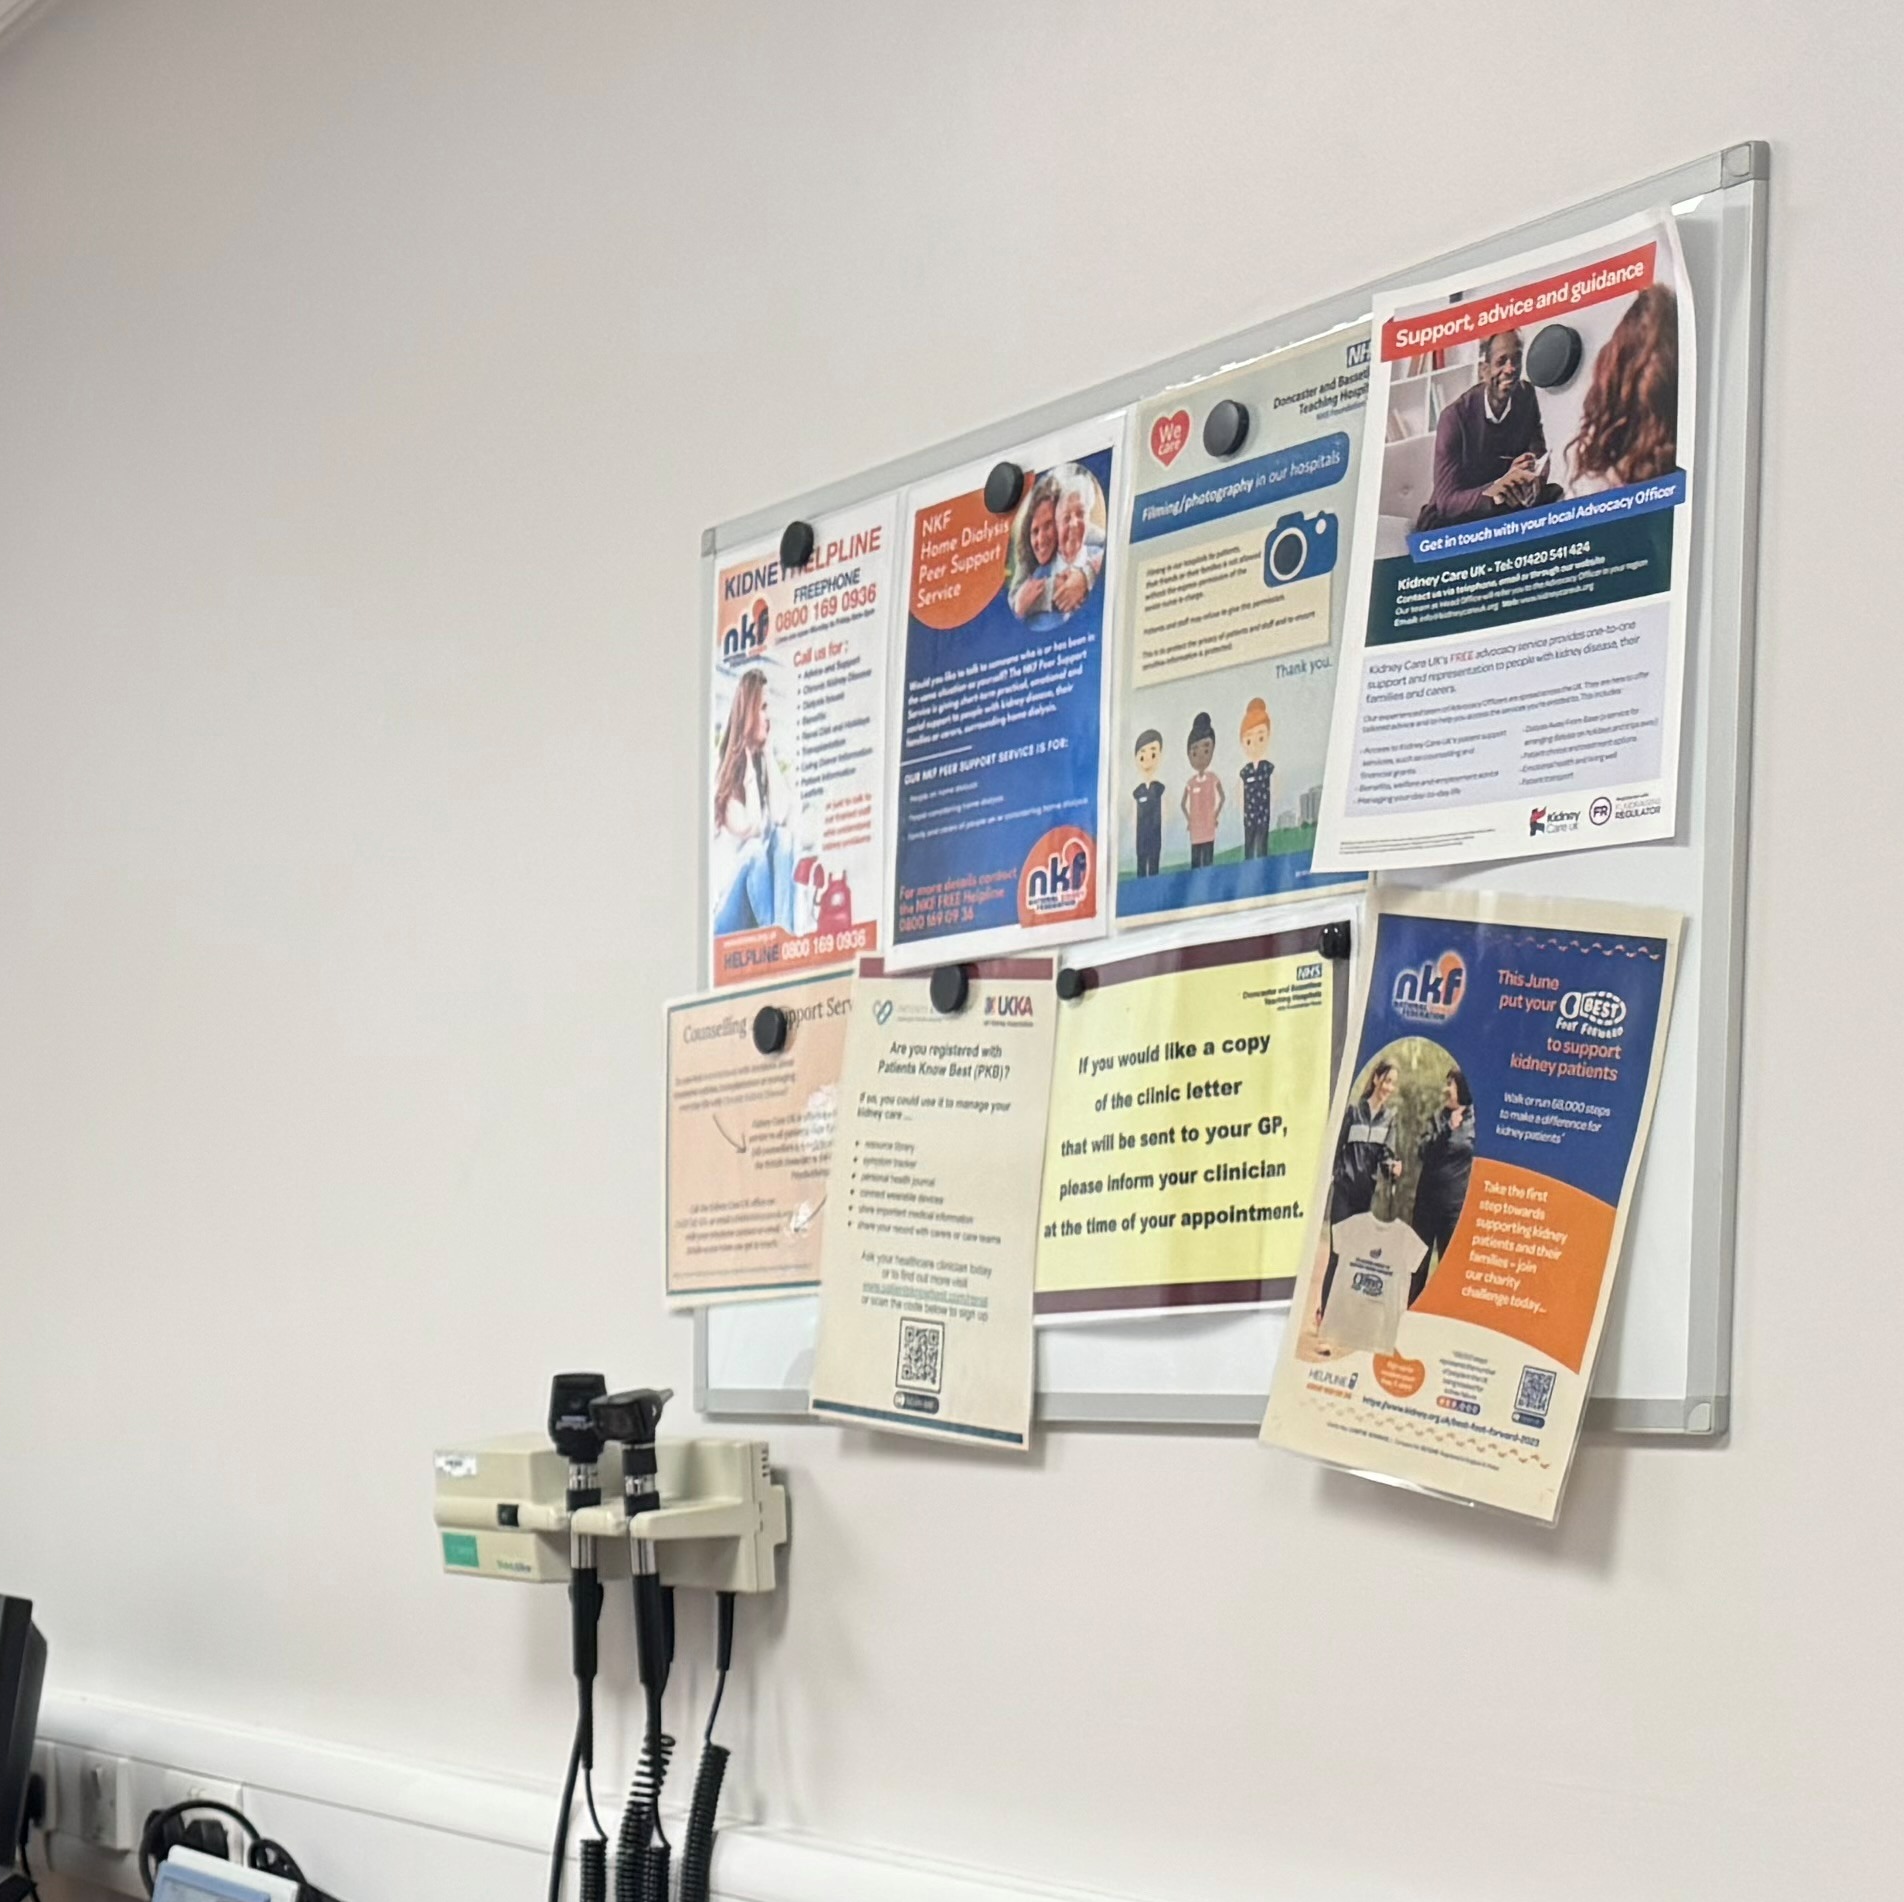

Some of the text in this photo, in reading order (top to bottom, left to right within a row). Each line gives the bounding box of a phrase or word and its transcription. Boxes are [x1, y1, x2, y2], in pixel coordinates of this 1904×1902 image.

[1396, 262, 1643, 347] Support, advice and guidance
[1273, 376, 1337, 409] Doncaster and
[1299, 395, 1338, 415] Teaching
[1158, 436, 1181, 455] care
[1159, 424, 1181, 443] We
[1142, 450, 1340, 520] Filming/photography in our hospitals
[922, 510, 951, 536] NKF
[1419, 485, 1675, 552] Get in touch with your local Advocacy Officer
[921, 514, 1009, 559] Home Dialysis
[790, 526, 882, 578] ELPLINE
[919, 544, 1000, 583] Peer Support
[1398, 541, 1590, 590] Kidney Care UK Tel: 01420 541 424
[794, 568, 859, 602] FREEPHONE
[917, 583, 961, 607] Service
[775, 605, 808, 632] 0800
[814, 595, 837, 619] 169
[841, 583, 876, 611] 0936
[724, 606, 768, 654] nkf
[793, 641, 842, 667] Call us for
[1276, 660, 1307, 679] Thank
[904, 772, 920, 785] OUR
[939, 762, 957, 776] PEER
[959, 753, 996, 772] SUPPORT
[998, 744, 1033, 762] SERVICE
[1036, 742, 1045, 753] IS
[1593, 805, 1608, 818] FR
[1615, 806, 1661, 819] REGULATOR
[1029, 851, 1086, 896] nkf
[725, 943, 778, 968] HELPLINE
[782, 939, 809, 960] 0800
[813, 934, 834, 954] 169
[836, 929, 865, 950] 0936
[1298, 965, 1321, 979] NHS
[1397, 963, 1462, 1005] nkf
[1497, 969, 1559, 990] This June
[1499, 995, 1556, 1012] put your
[1584, 997, 1620, 1018] BEST
[683, 996, 852, 1044] Counselling upport Serv
[890, 1041, 1002, 1058] Are you registered with
[1078, 1035, 1270, 1076] If you would like a copy
[1547, 1037, 1621, 1059] to support
[878, 1060, 1010, 1080] Patients Know Best (PKB)?
[1510, 1055, 1617, 1081] kidney patients
[1095, 1080, 1242, 1112] of the clinic letter
[1061, 1116, 1287, 1156] that will be sent to your GP,
[1059, 1161, 1285, 1200] please inform your clinician
[1484, 1181, 1548, 1202] Take the first
[1044, 1203, 1302, 1238] at the time of your appointment.
[1479, 1200, 1545, 1220] step towards
[1476, 1218, 1567, 1244] supporting kidney
[1472, 1235, 1562, 1259] patients and their
[1469, 1250, 1537, 1273] families join
[1465, 1270, 1520, 1290] our charity
[1462, 1286, 1508, 1306] challenge
